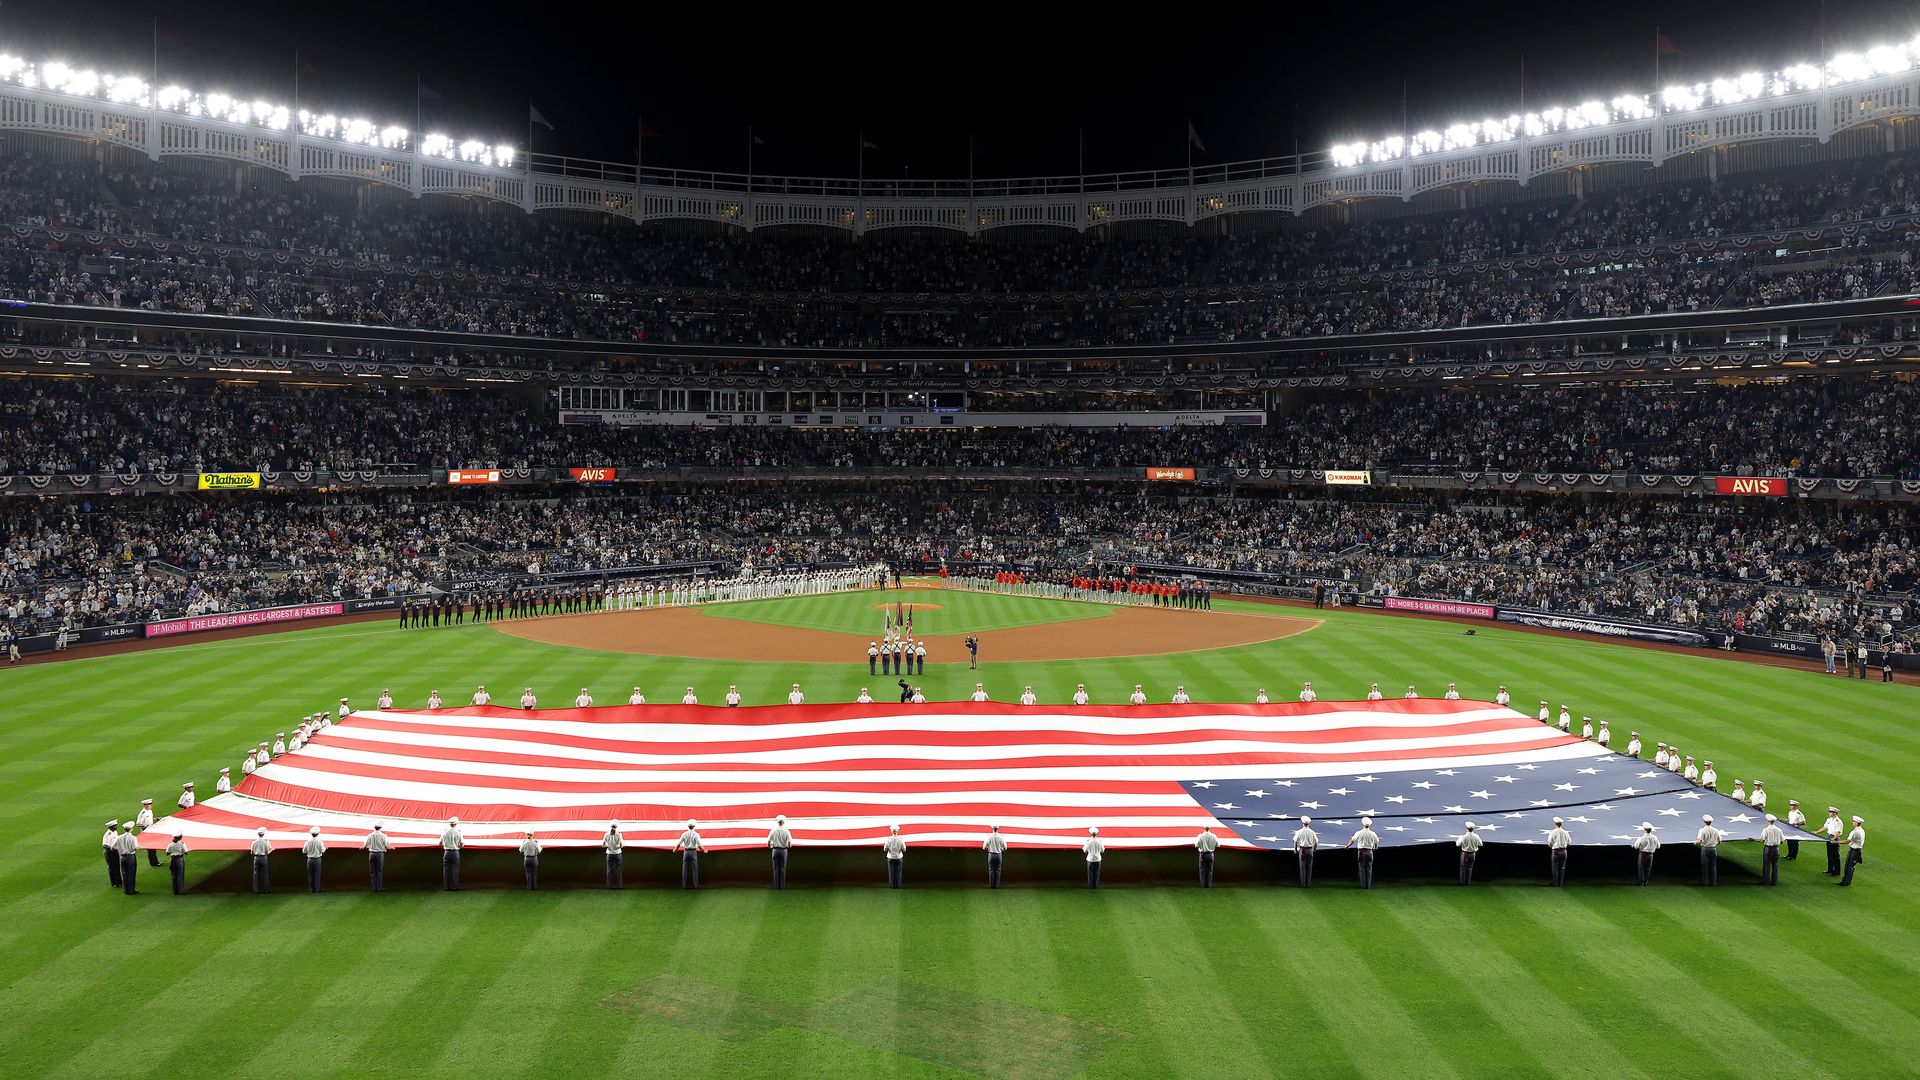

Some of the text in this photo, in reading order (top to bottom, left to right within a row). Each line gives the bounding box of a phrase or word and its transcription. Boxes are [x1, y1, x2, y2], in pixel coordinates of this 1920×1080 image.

[205, 474, 254, 486] Nathan's
[580, 469, 605, 480] AVIS
[1732, 479, 1770, 493] AVIS
[1424, 603, 1440, 611] BARS
[1448, 605, 1466, 613] MORE
[1466, 607, 1489, 616] PLACES
[161, 622, 186, 632] Mobile
[190, 621, 206, 630] THE
[207, 616, 237, 627] LEADER
[248, 614, 260, 622] 5G.
[261, 610, 293, 620] LARGEST
[301, 606, 336, 616] FASTEST.
[1562, 620, 1585, 631] enjoy
[1585, 622, 1601, 631] the
[1780, 643, 1796, 651] MLB
